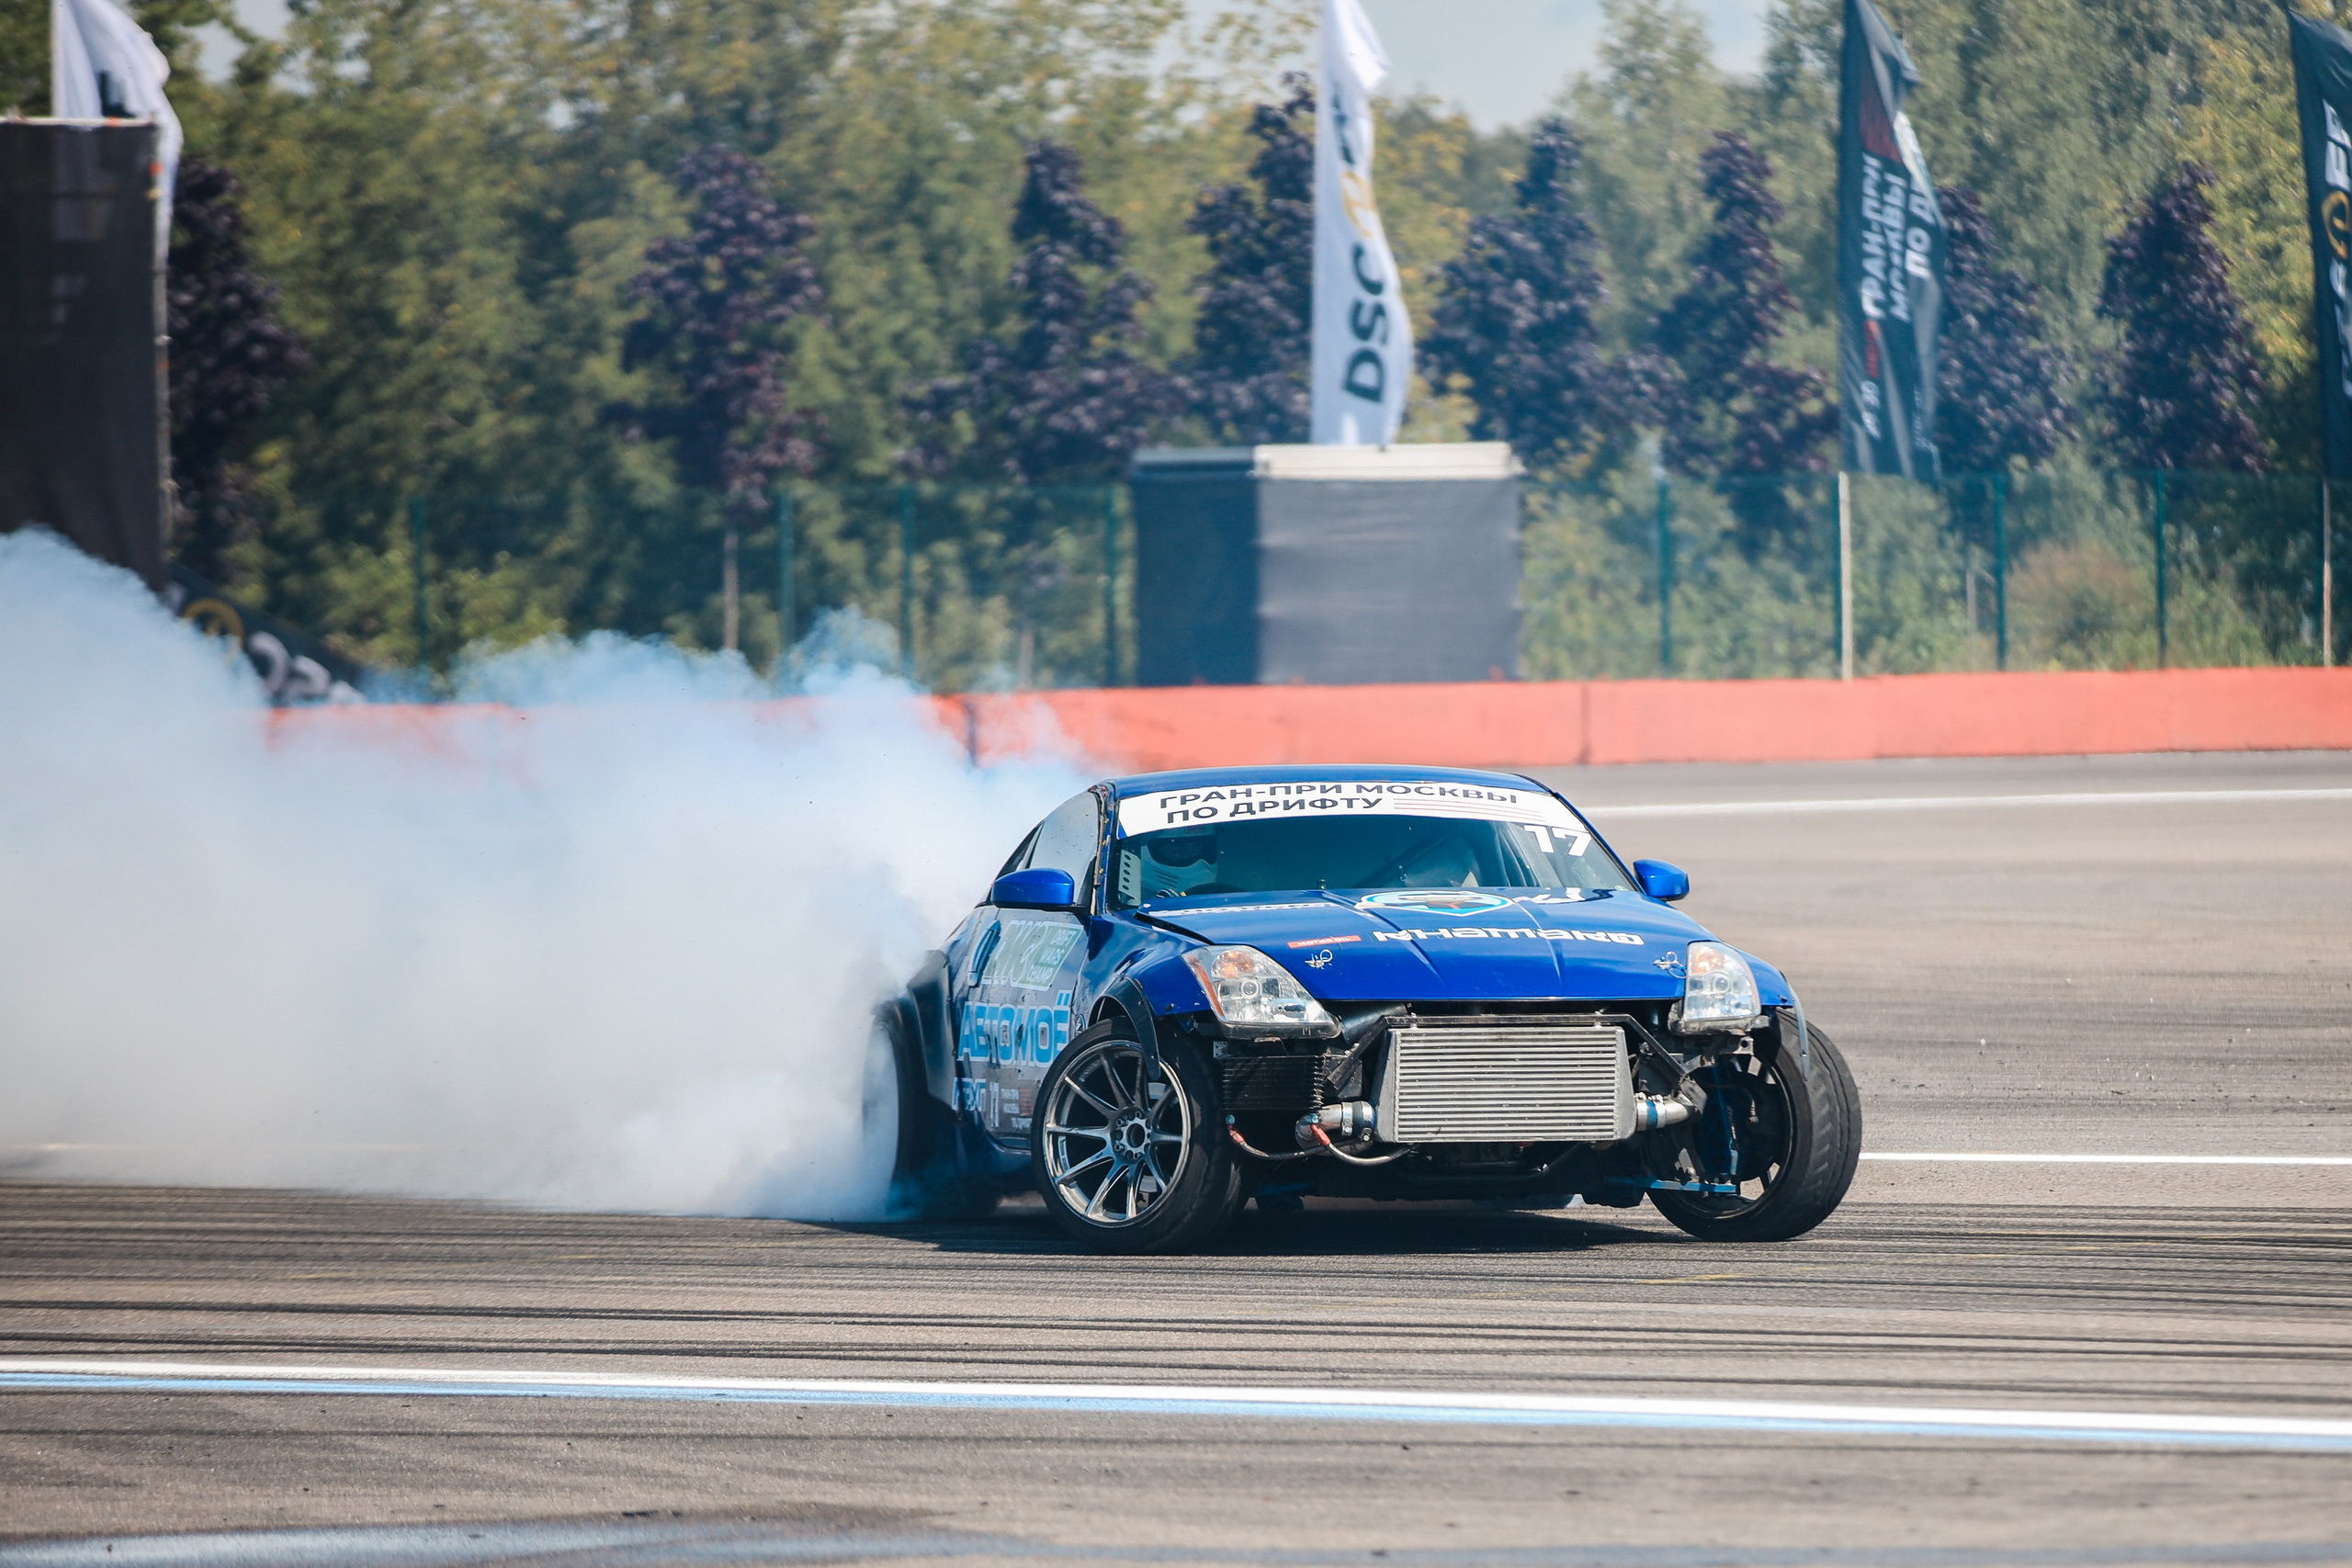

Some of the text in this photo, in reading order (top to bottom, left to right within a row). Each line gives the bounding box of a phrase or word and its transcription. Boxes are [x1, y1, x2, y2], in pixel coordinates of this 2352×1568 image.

[1905, 227, 1931, 278] ПО
[1160, 784, 1517, 808] ГРАН-ПРИ МОСКВЫ
[1167, 797, 1383, 824] ПО ДРИФТУ
[1523, 824, 1591, 857] 17
[1296, 938, 1333, 946] MOTOR
